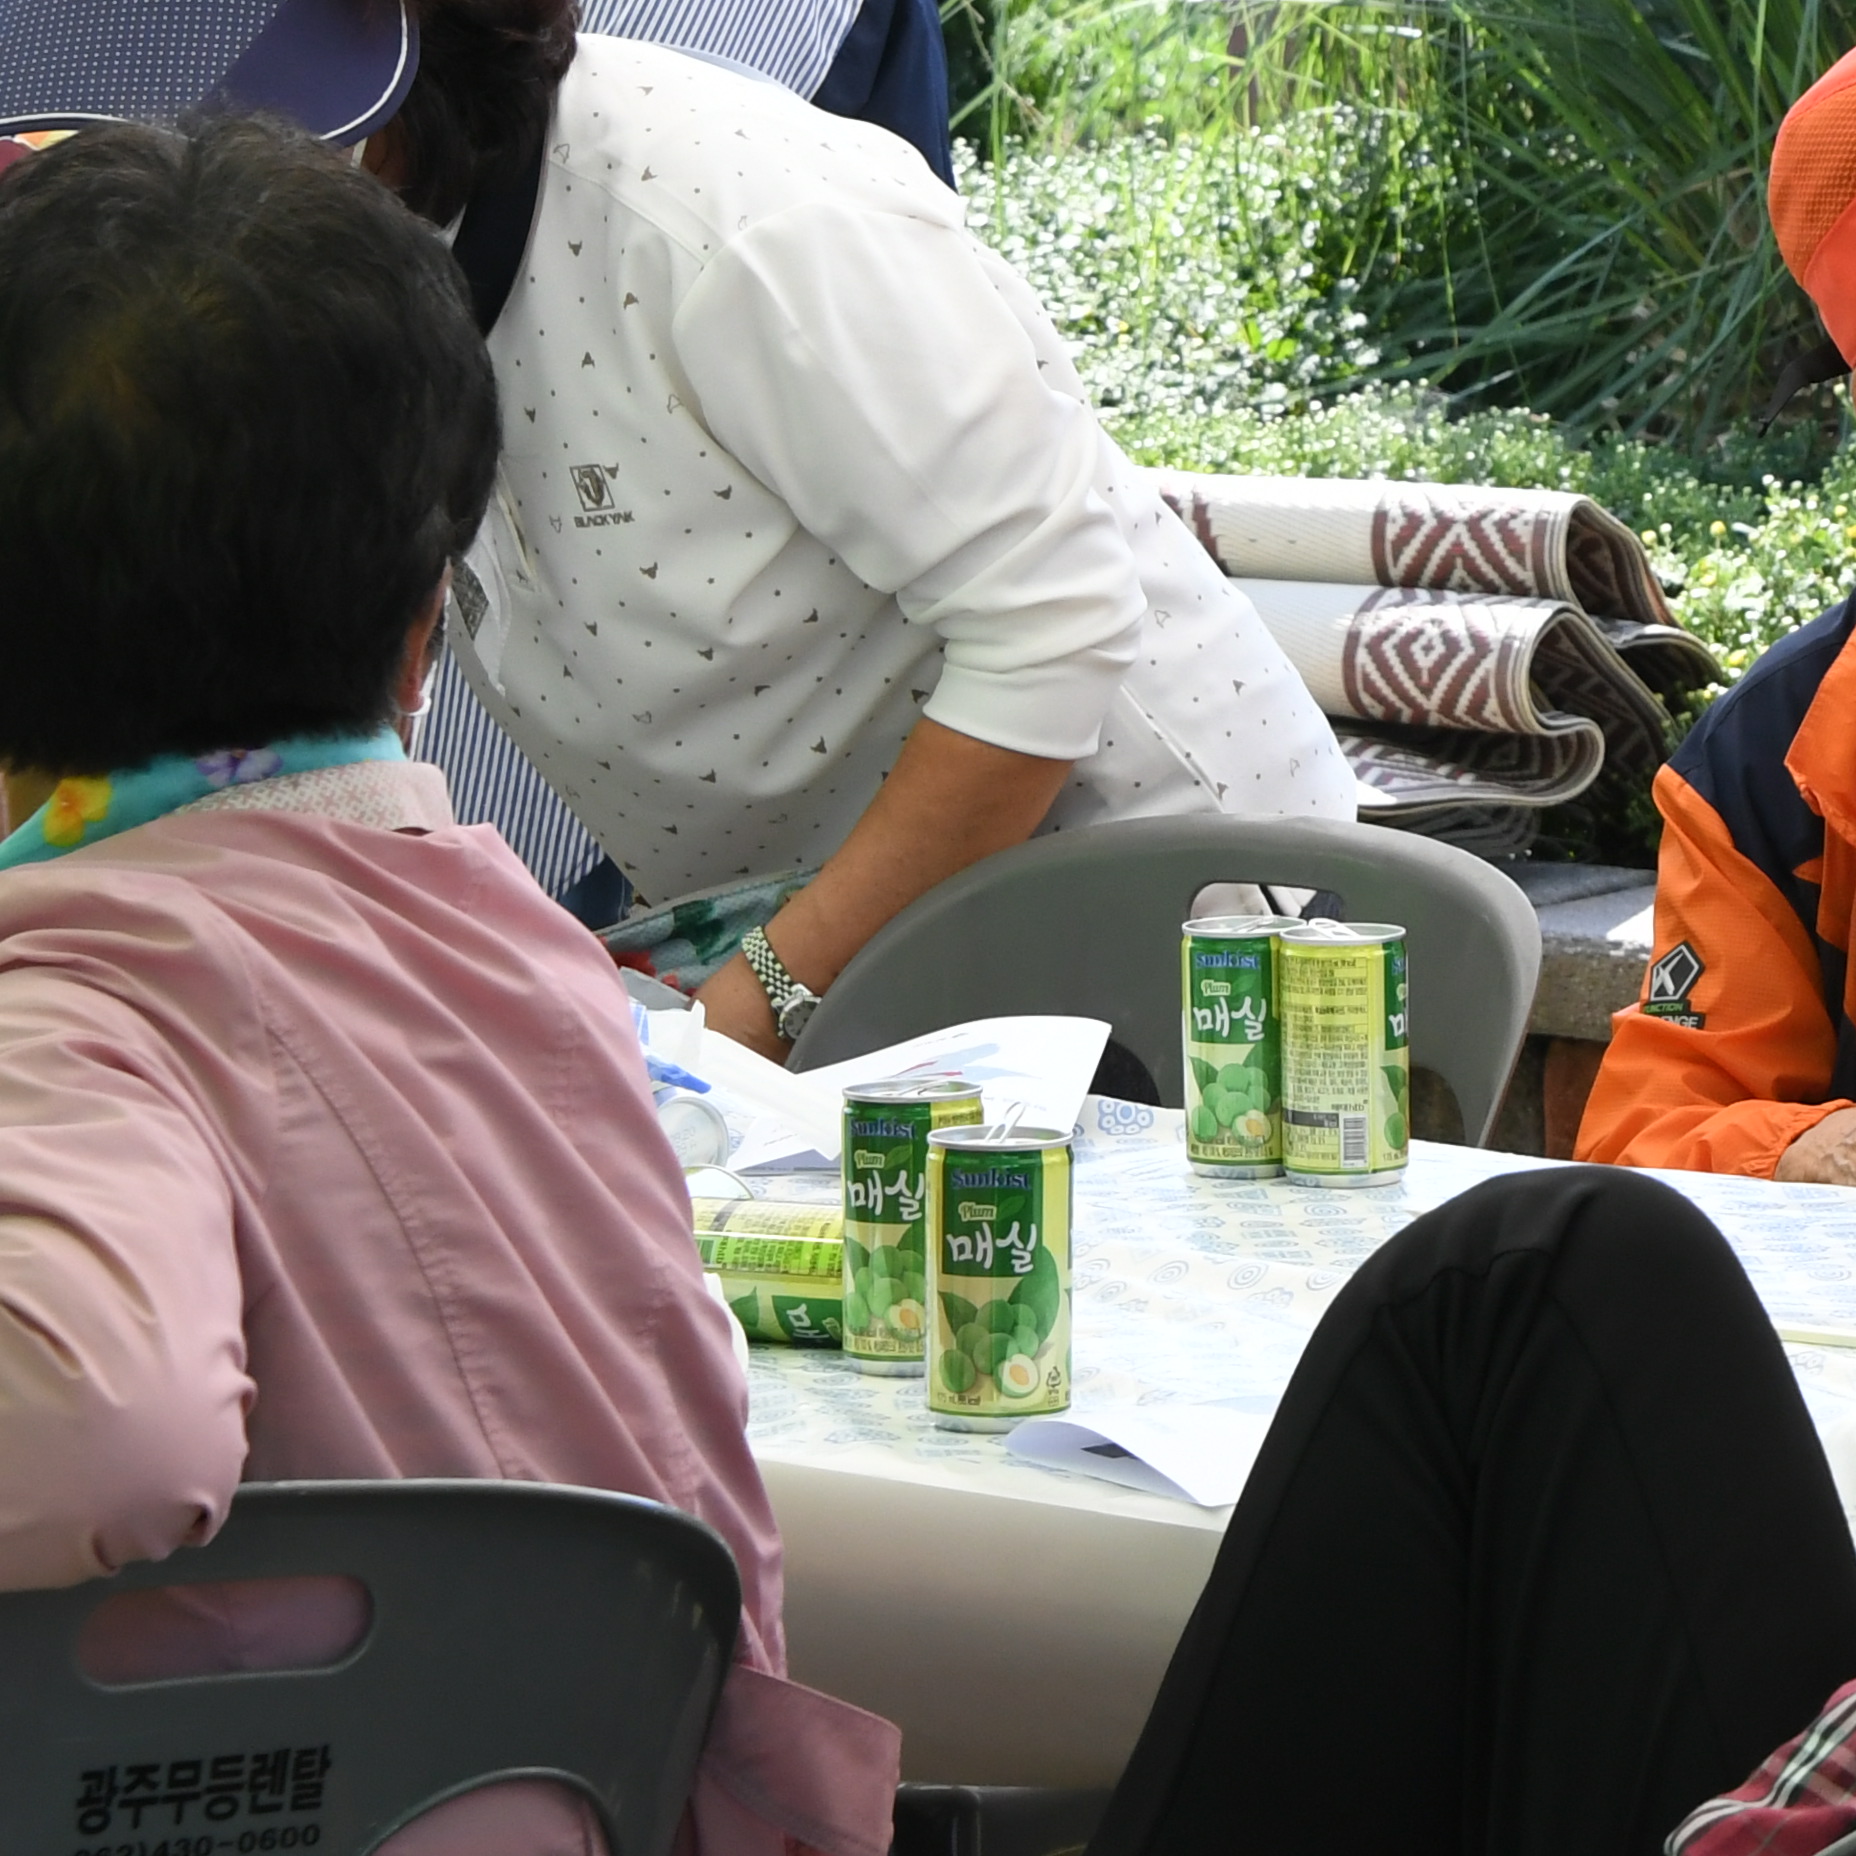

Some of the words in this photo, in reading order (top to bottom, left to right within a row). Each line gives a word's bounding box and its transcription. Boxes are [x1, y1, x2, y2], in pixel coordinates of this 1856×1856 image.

[1195, 950, 1259, 970] Sunkist
[1204, 981, 1229, 994] Plum
[1193, 996, 1267, 1041] 매실
[850, 1118, 917, 1140] Sunkist
[856, 1151, 883, 1167] Plum
[952, 1167, 1032, 1190] Sunkist
[847, 1170, 925, 1221] 매실
[960, 1203, 995, 1220] Plum
[946, 1221, 1037, 1274] 매실
[76, 1744, 332, 1835] 광주무등렌탈
